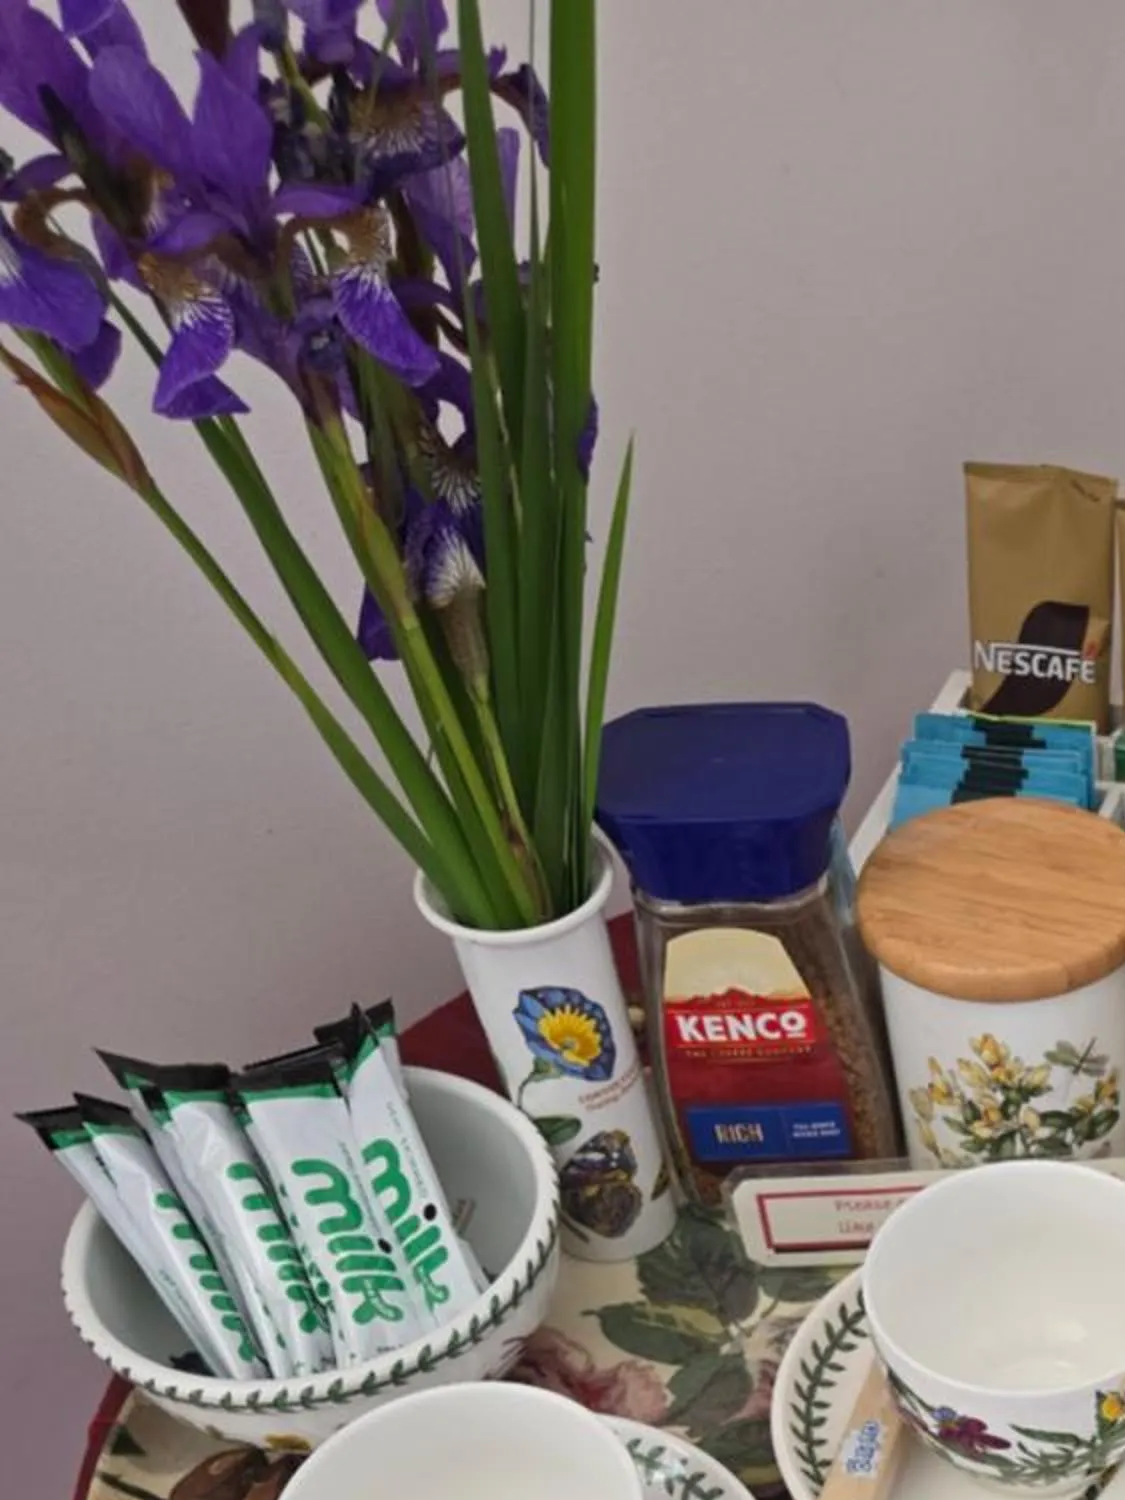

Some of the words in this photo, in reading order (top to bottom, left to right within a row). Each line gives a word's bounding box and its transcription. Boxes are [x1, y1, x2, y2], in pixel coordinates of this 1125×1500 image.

[675, 1010, 807, 1043] KENCO
[713, 1122, 764, 1144] RICH
[291, 1158, 406, 1326] milk
[361, 1138, 449, 1311] milk
